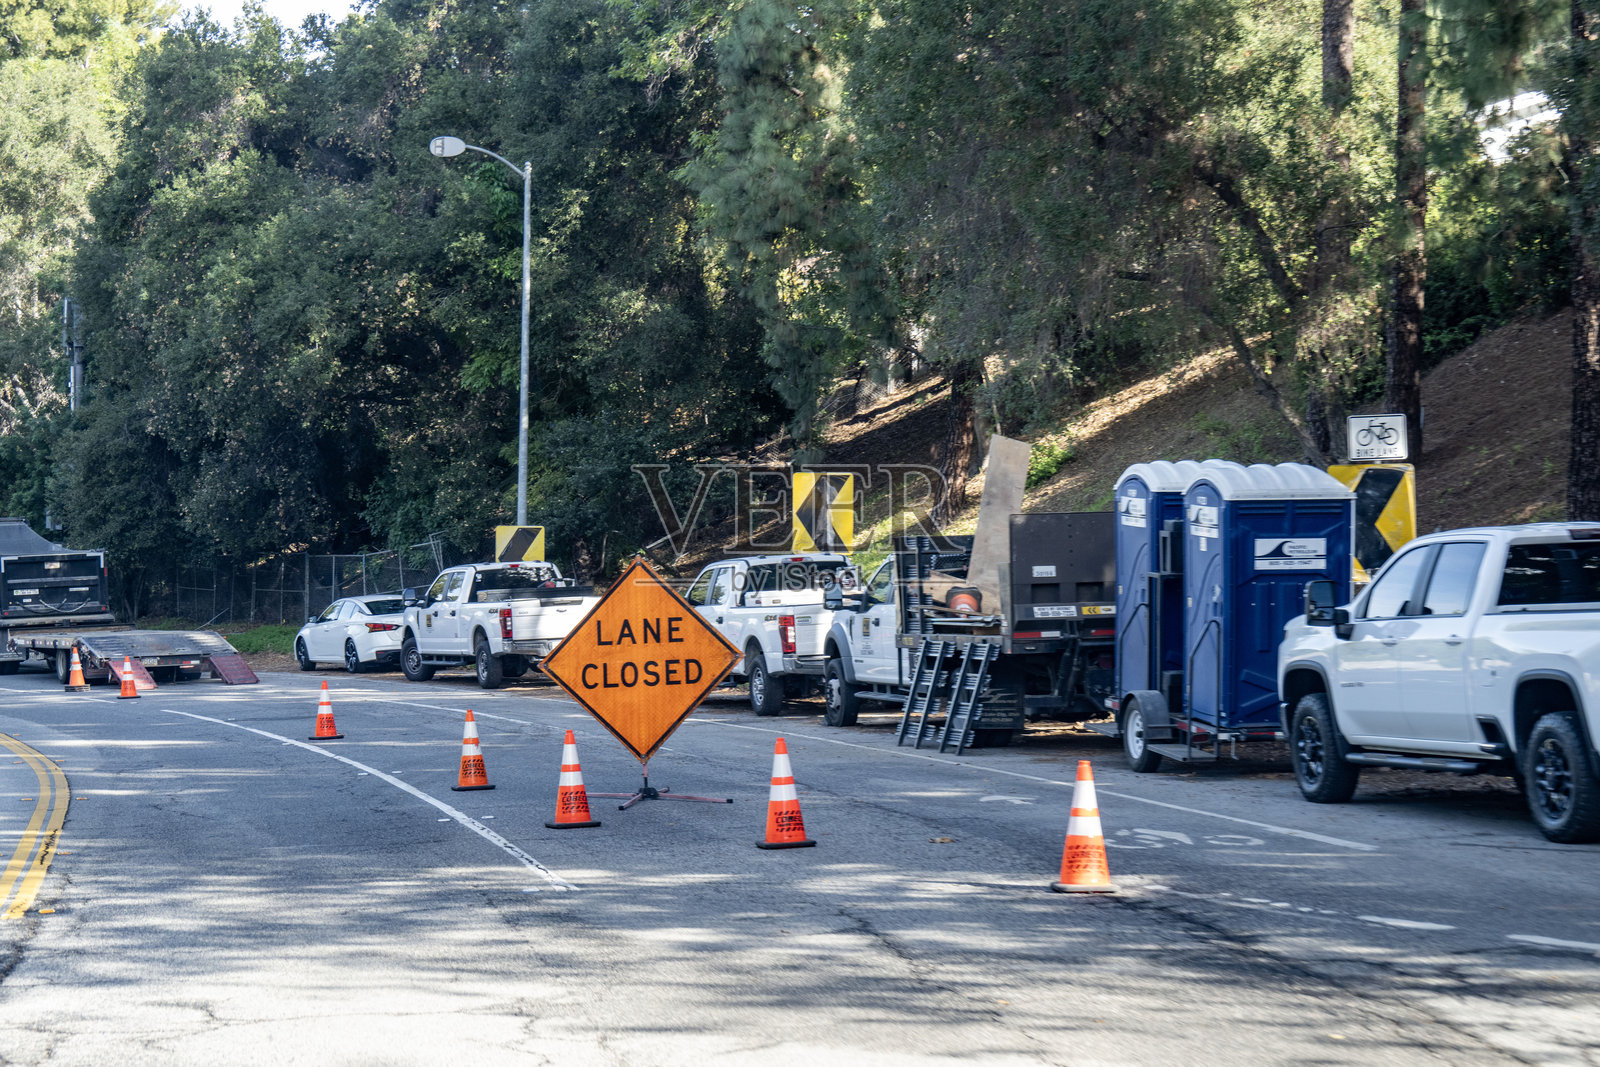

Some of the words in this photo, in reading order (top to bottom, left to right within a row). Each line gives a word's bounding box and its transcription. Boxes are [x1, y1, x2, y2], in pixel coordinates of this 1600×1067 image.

[1356, 448, 1375, 457] BIKE
[596, 617, 684, 646] LANE
[581, 658, 703, 689] CLOSED
